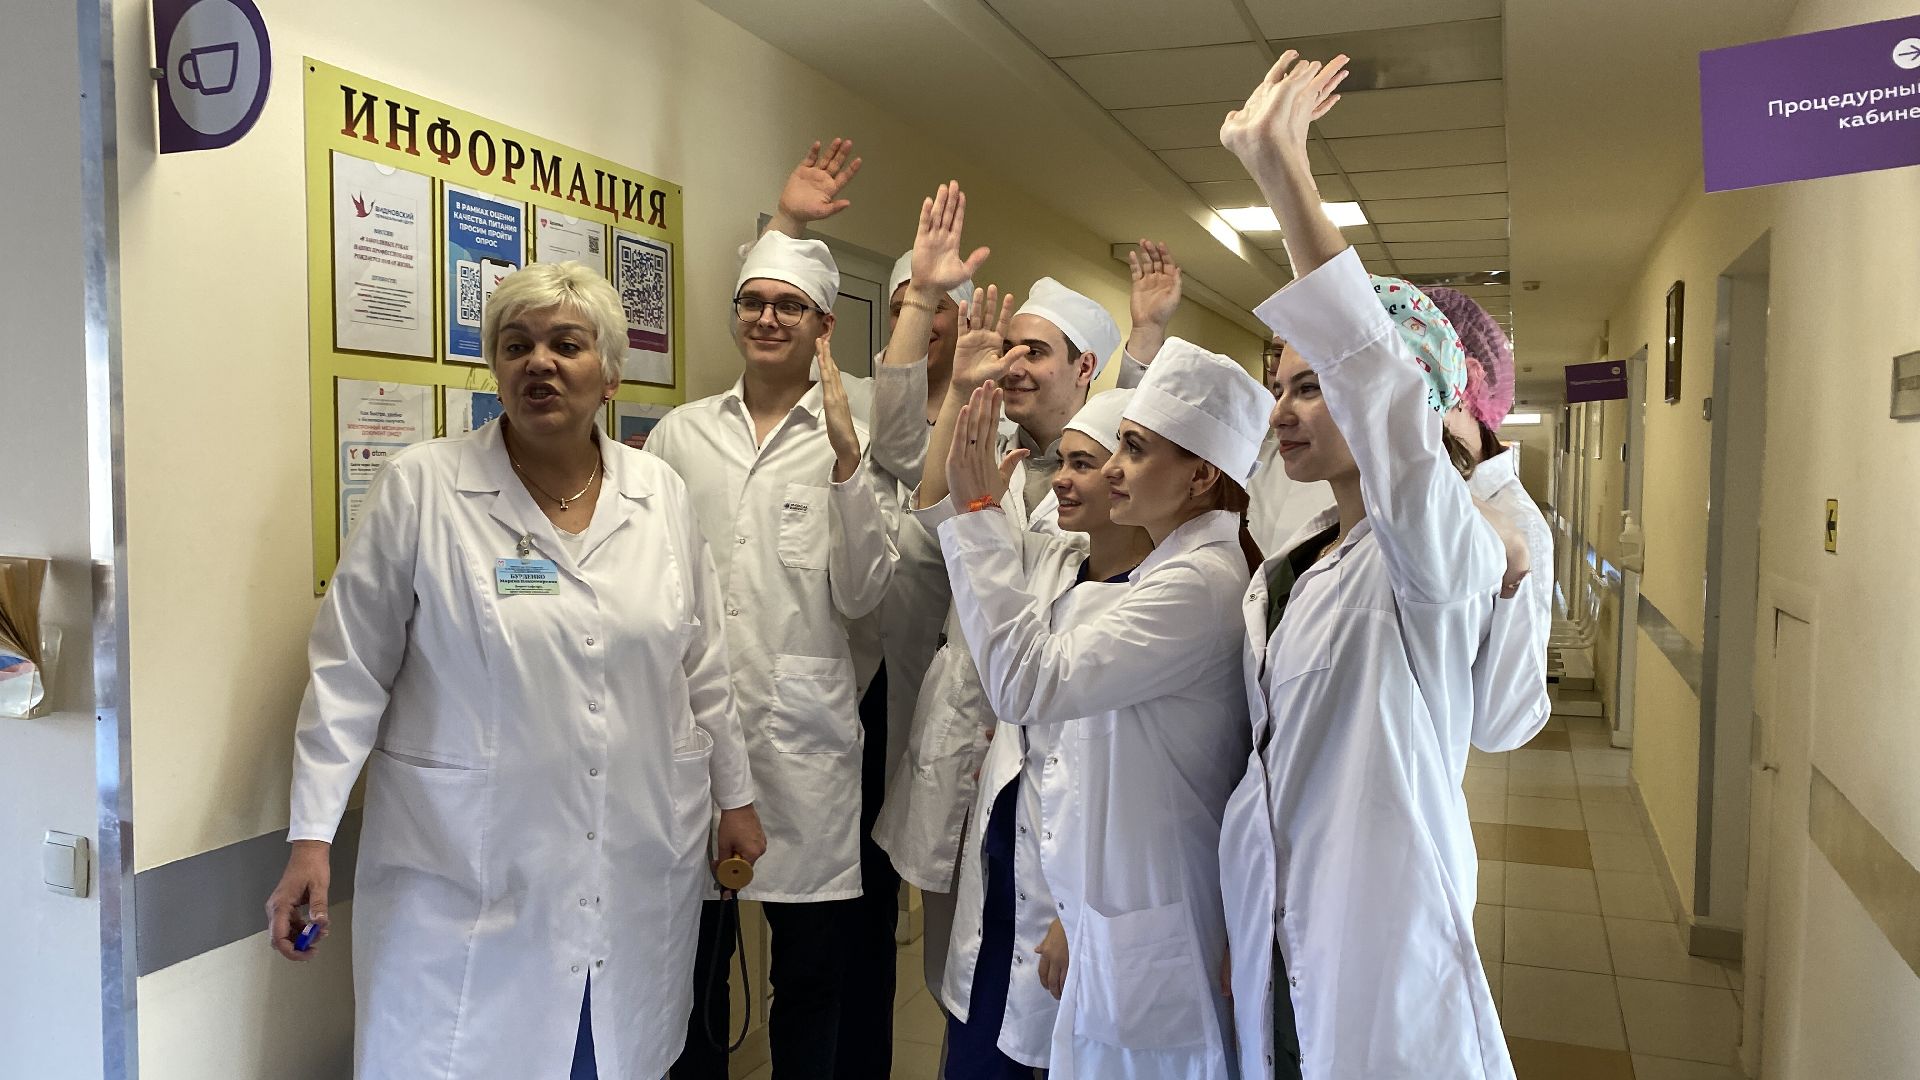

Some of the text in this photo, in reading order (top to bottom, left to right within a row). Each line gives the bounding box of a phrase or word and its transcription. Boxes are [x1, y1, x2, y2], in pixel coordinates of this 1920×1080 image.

[1768, 82, 1920, 118] Процедурны
[340, 84, 667, 231] ИНФОРМАЦИЯ
[453, 211, 517, 233] КАЧЕСТВА ПИТАНИЯ
[456, 201, 515, 223] В РАМКАХ ОЦЕНКИ
[459, 222, 512, 241] ПРОСИМ ПРОЙТИ
[475, 236, 498, 248] ОПРОС
